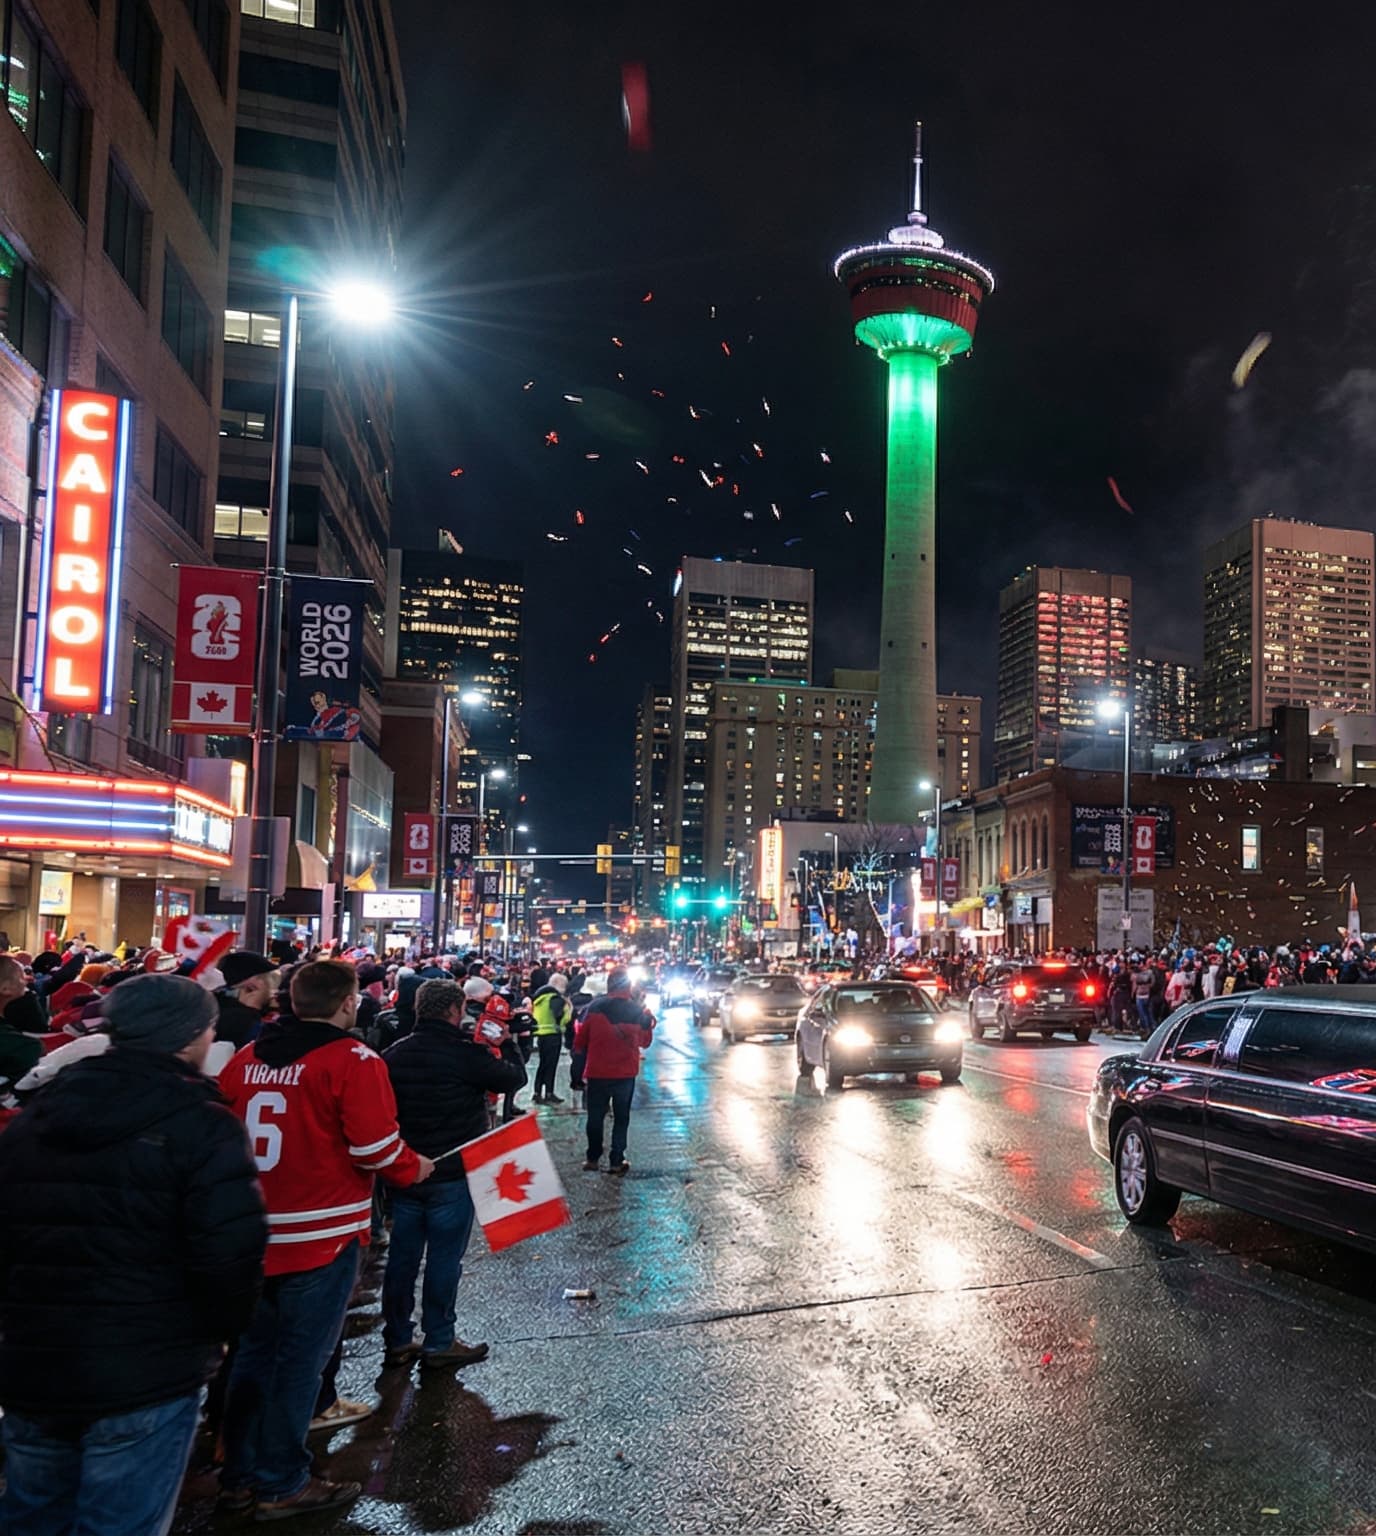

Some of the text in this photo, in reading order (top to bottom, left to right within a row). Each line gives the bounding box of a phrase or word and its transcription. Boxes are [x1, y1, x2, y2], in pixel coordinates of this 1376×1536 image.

[50, 402, 109, 697] CAIROL
[299, 602, 321, 677] WORLD
[320, 604, 351, 679] 2026
[245, 1091, 287, 1172] 6
